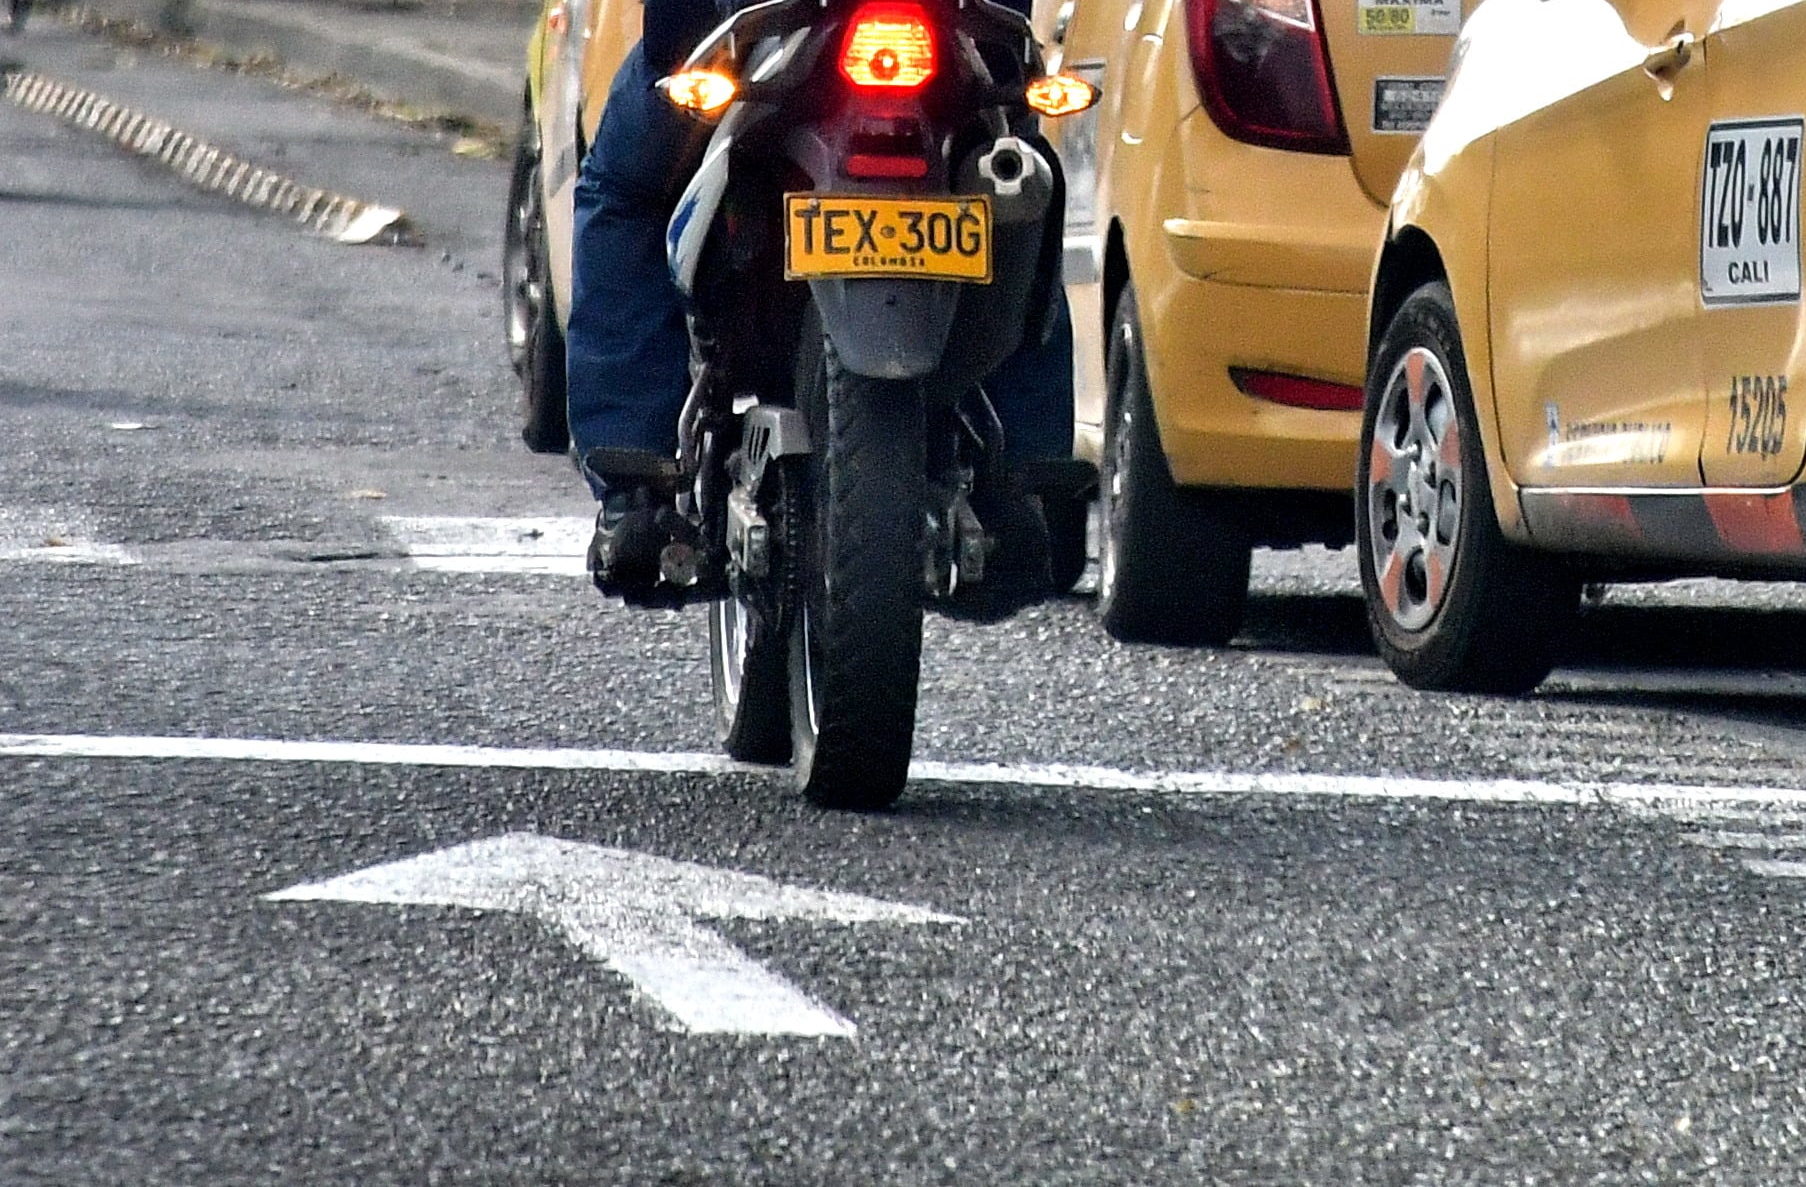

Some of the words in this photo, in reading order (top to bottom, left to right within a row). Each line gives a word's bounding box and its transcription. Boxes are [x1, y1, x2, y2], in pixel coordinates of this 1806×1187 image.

[1708, 138, 1799, 249] TZO-887
[794, 208, 879, 254] TEX
[900, 210, 980, 257] 30G
[1728, 260, 1770, 284] CALI
[1727, 375, 1788, 458] 15205
